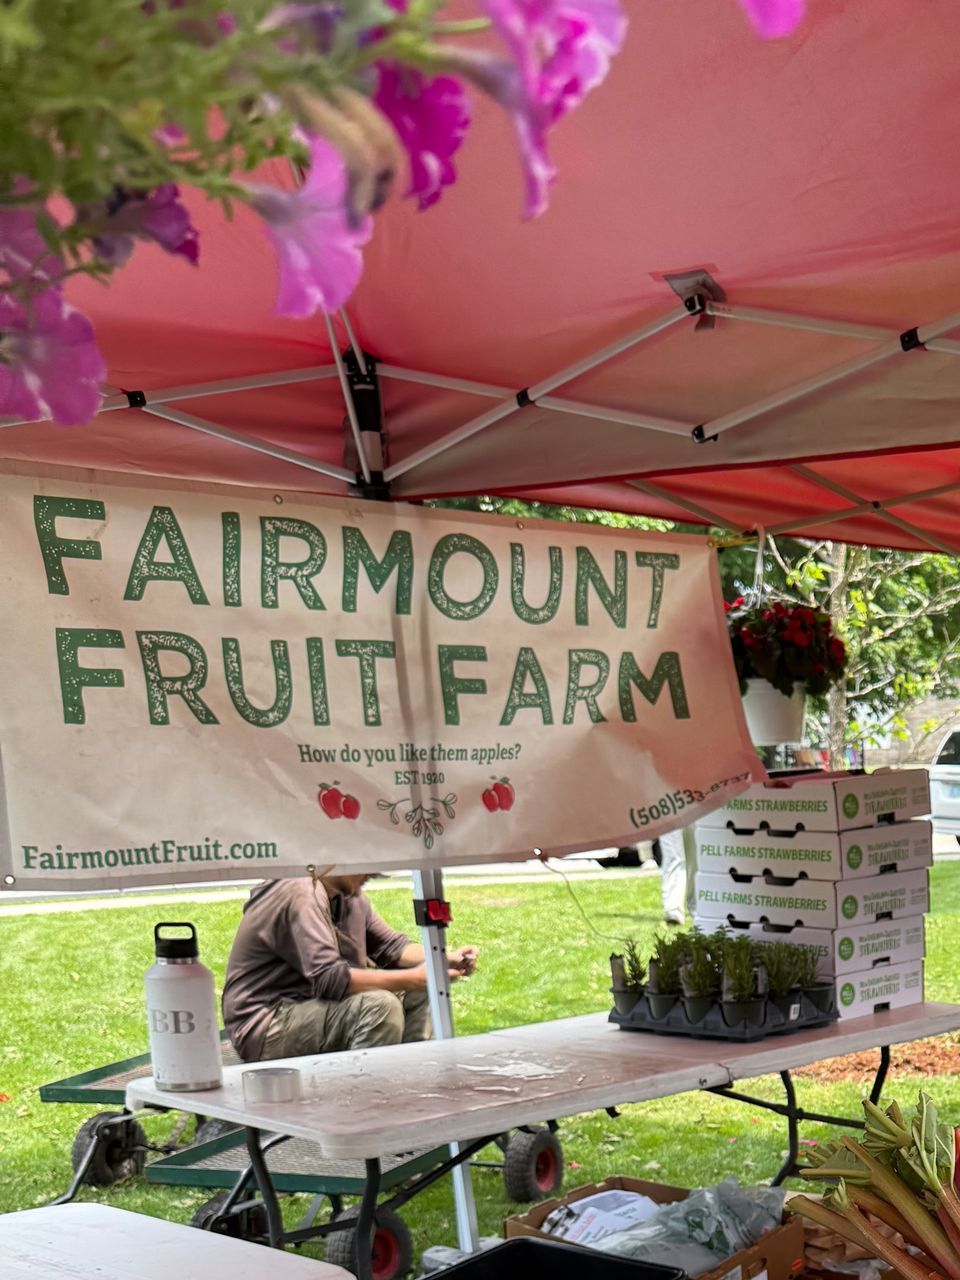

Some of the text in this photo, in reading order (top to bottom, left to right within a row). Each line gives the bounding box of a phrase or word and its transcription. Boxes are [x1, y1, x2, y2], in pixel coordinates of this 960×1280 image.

[33, 495, 680, 630] FAIRMOUNT
[55, 627, 690, 727] FRUIT FARM
[298, 743, 522, 767] How do you like them apples?
[394, 771, 444, 785] EST 1920
[726, 799, 828, 813] ARMS STRAWBERRIES
[21, 837, 278, 870] FairmountFruit.com
[700, 844, 832, 862] PELL FARMS STRAWBERRIES
[699, 890, 719, 901] PELL
[722, 891, 752, 905] FARMS
[754, 895, 828, 910] STRAWBERRIES
